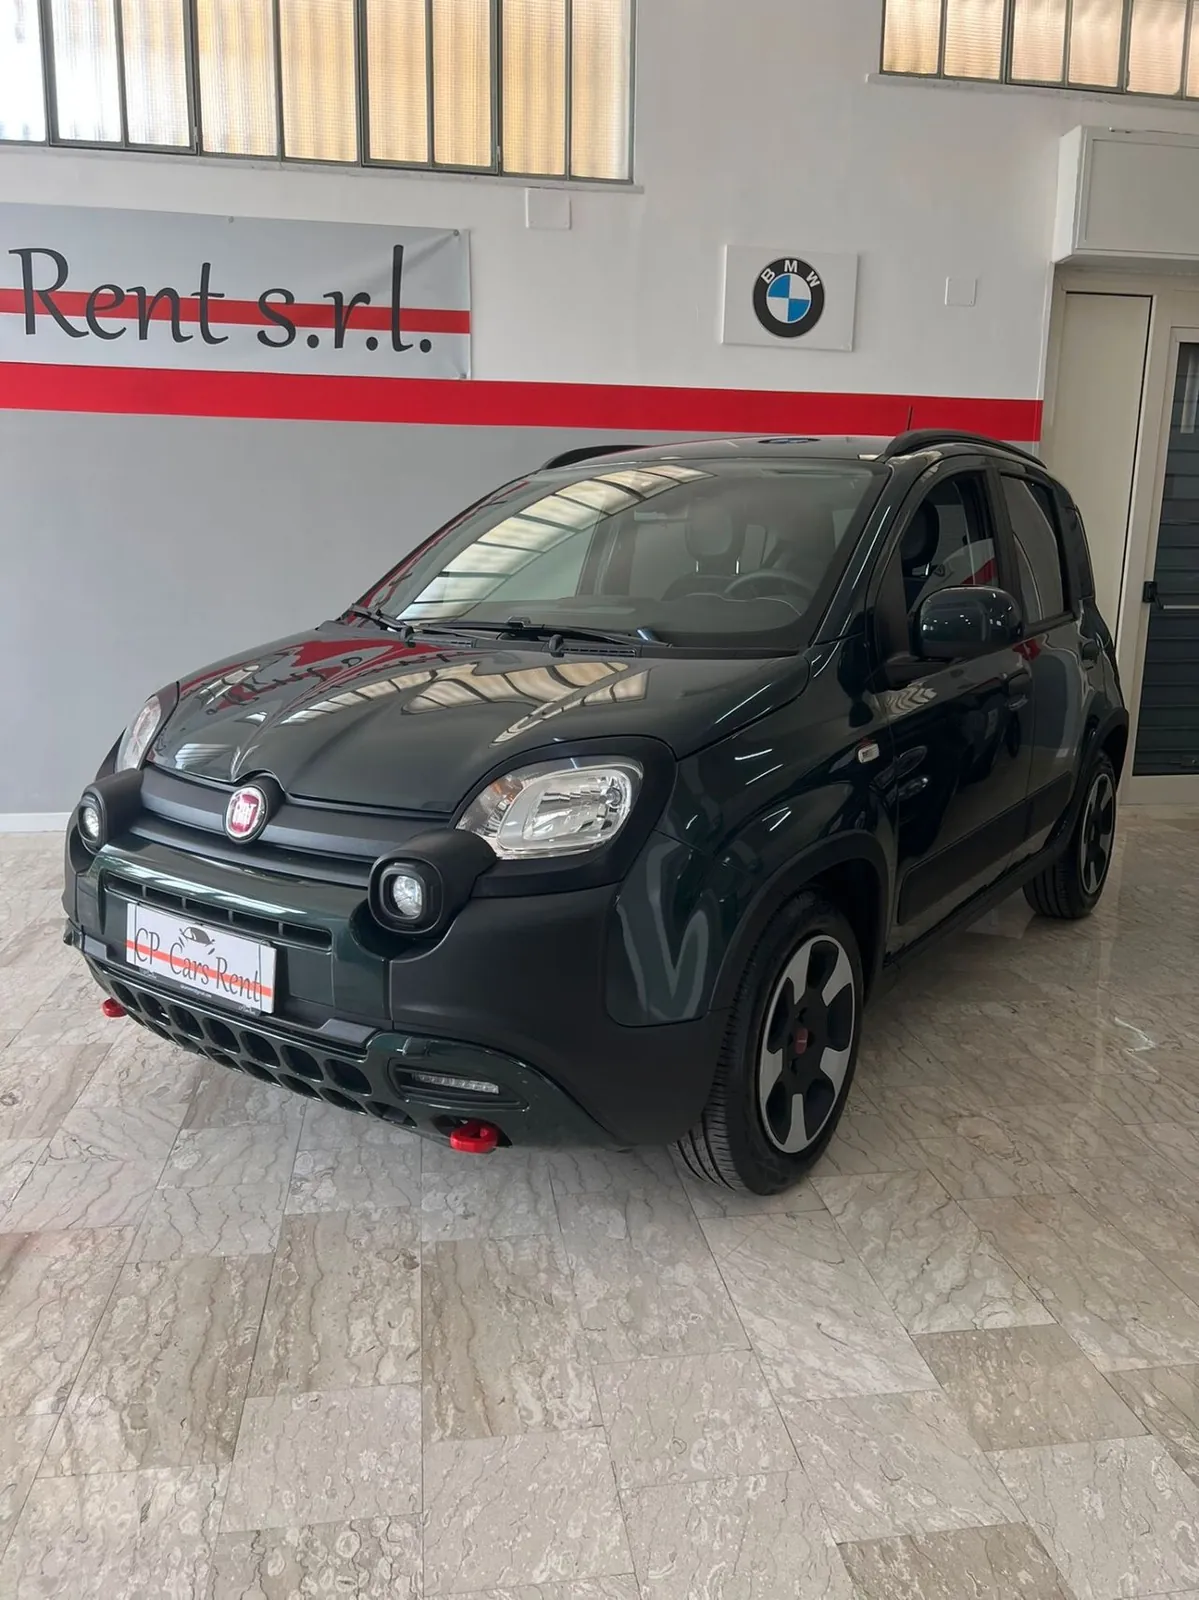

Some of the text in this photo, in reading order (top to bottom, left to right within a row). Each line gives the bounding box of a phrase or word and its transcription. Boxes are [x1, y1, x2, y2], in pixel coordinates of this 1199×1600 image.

[9, 244, 432, 353] Rent s.r.l.
[761, 259, 821, 288] BMW
[134, 927, 262, 1003] CP Cars Rent
